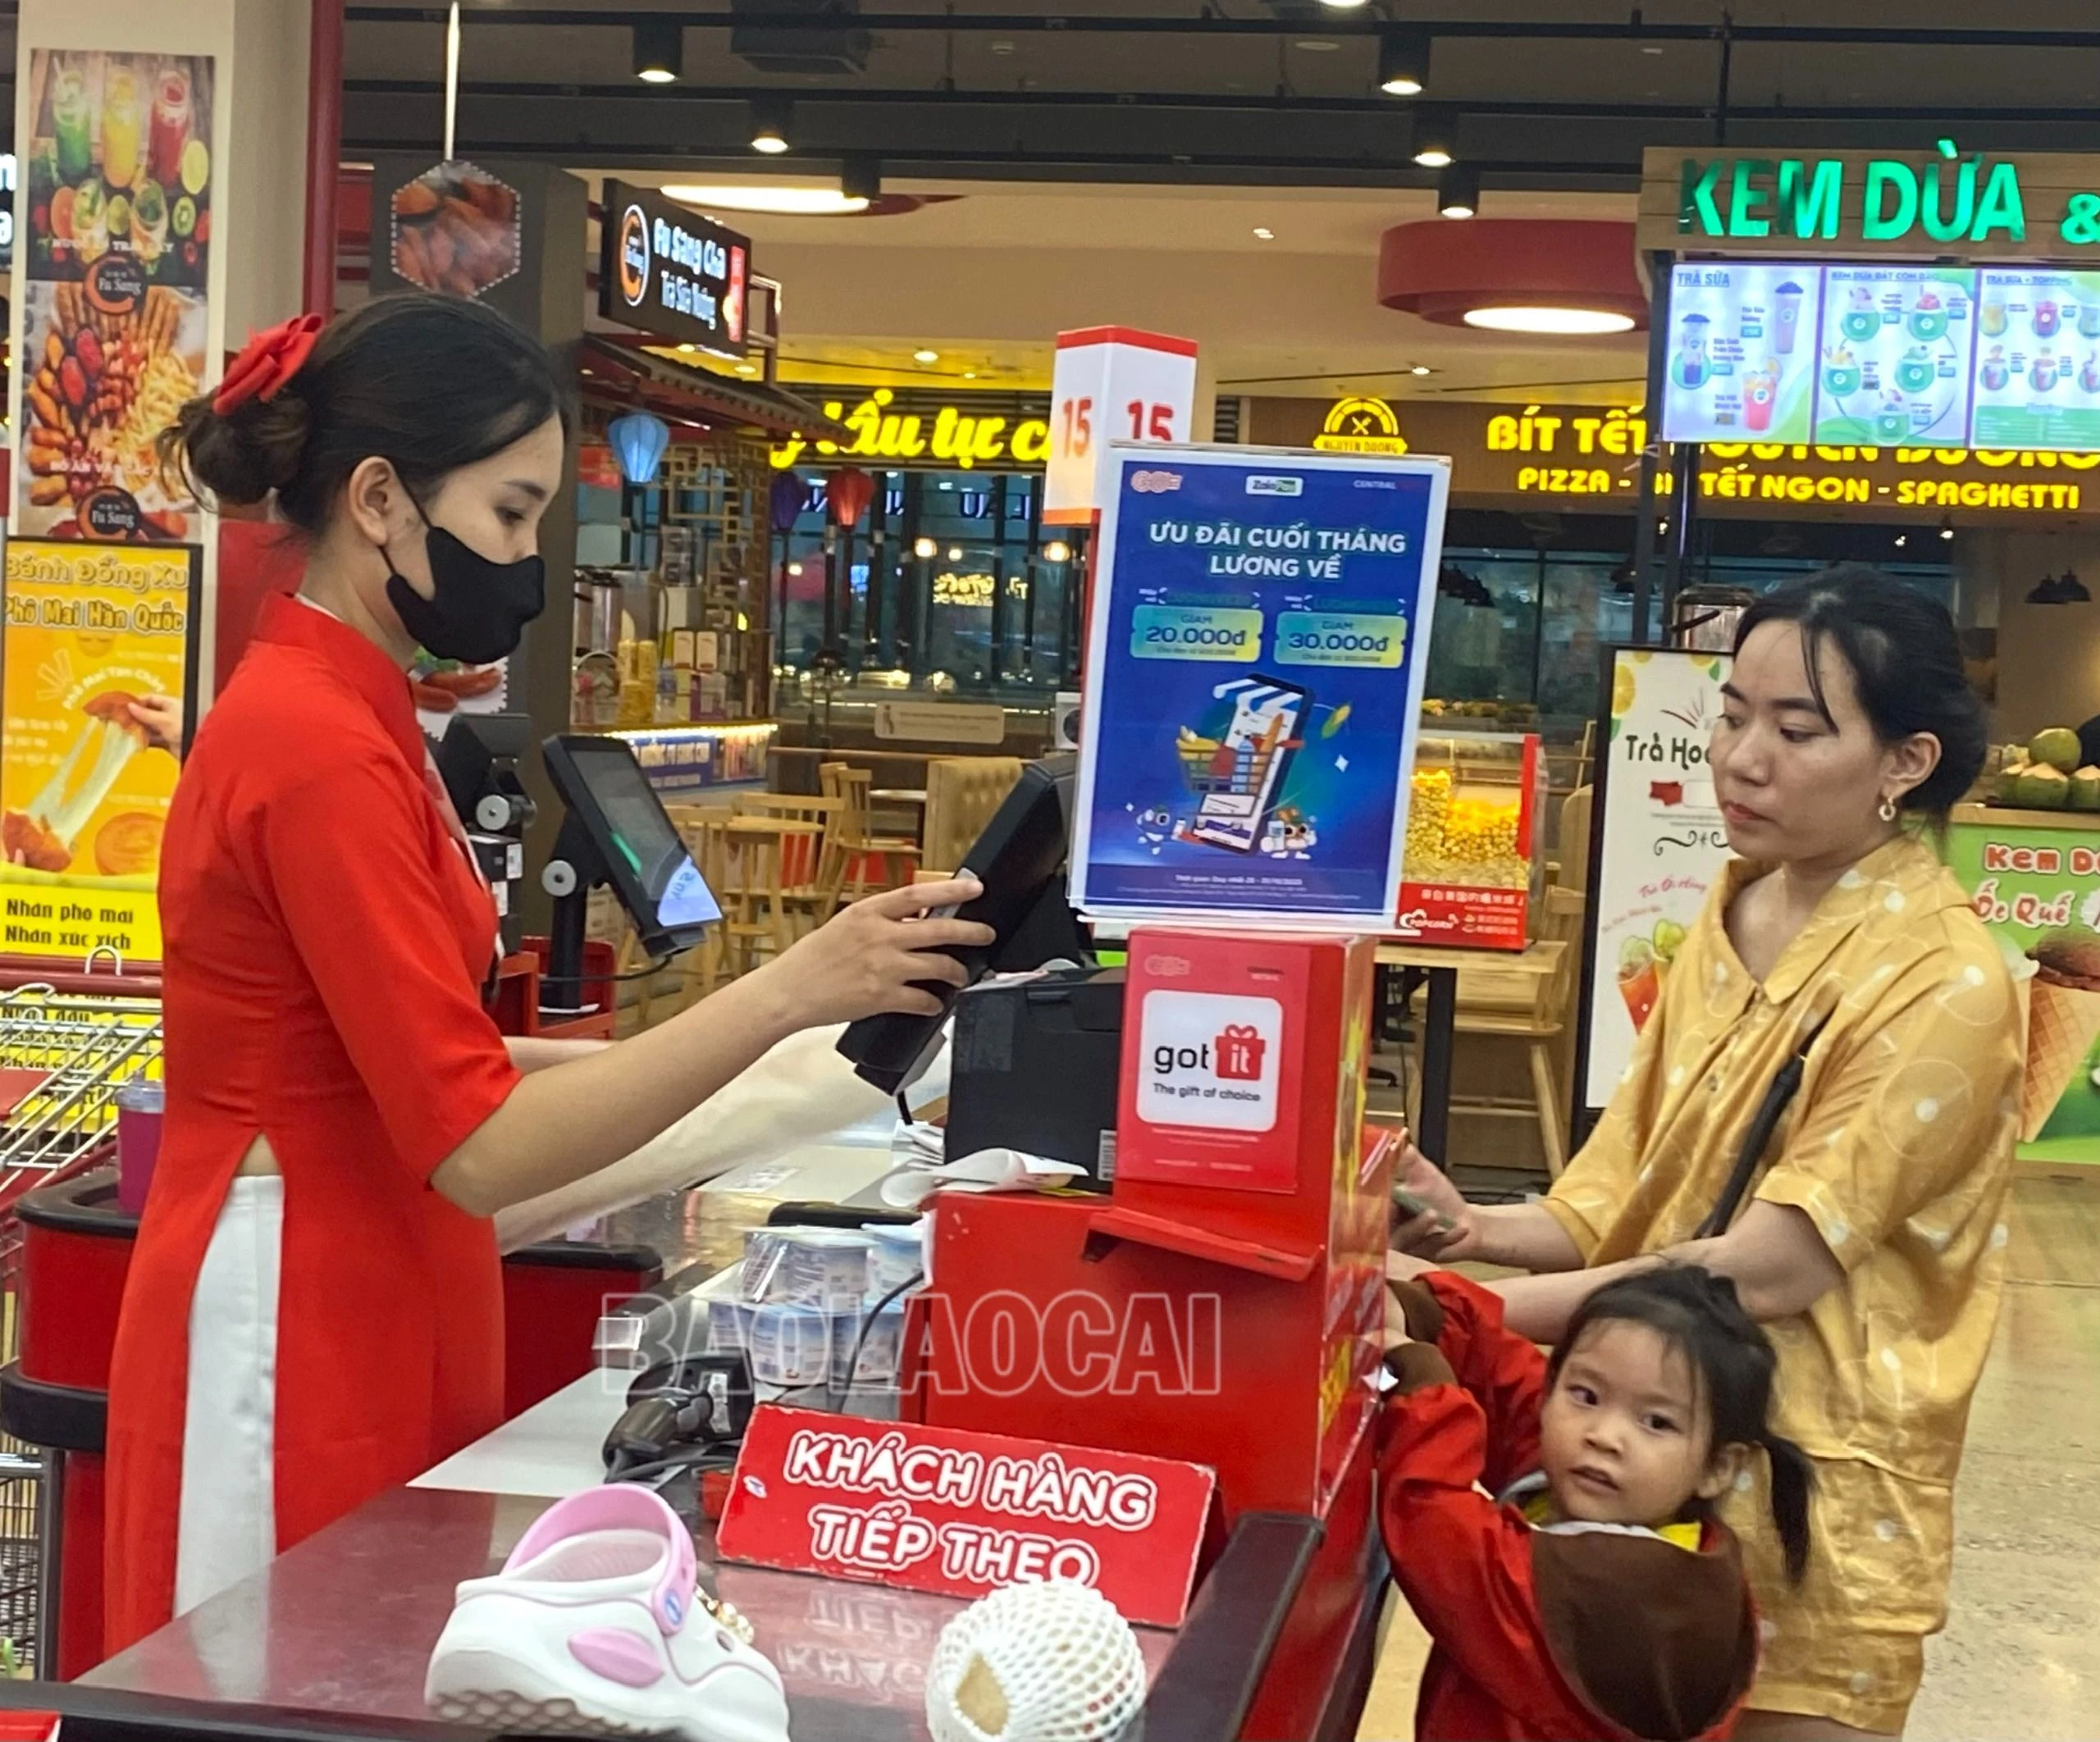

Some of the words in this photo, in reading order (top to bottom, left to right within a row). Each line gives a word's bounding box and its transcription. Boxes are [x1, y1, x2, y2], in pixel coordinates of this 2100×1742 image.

[1678, 157, 1842, 239] KEM
[1863, 138, 2025, 242] DỪA
[1063, 396, 1092, 458] 15
[1127, 399, 1174, 441] 15
[1487, 405, 1562, 453] BÍT
[1573, 404, 1646, 456] TẾT
[1518, 467, 1610, 494] PIZZA
[1699, 462, 1756, 498] TẾT
[1761, 473, 1870, 503] NGON
[1897, 481, 2081, 510] SPAGHETTI
[1150, 522, 1189, 544] ƯU
[1195, 518, 1240, 546] ĐÃI
[1247, 522, 1311, 550] CUỐI
[1317, 527, 1407, 554] THÁNG
[7, 554, 72, 585] Bánh
[1210, 554, 1299, 577] LƯƠNG
[1307, 554, 1343, 579] VỀ
[43, 597, 80, 627] Mai
[87, 599, 129, 629] Hàn
[134, 600, 185, 633] Quốc
[1146, 626, 1248, 646] 20.000đ
[1289, 632, 1389, 653] 30.000đ
[1625, 732, 1664, 762] Trà
[1984, 843, 2061, 874] Kem
[2070, 846, 2100, 876] D
[99, 908, 134, 924] mai
[2013, 891, 2075, 928] Quế
[1153, 1042, 1210, 1074] got
[1230, 1042, 1251, 1074] it
[1153, 1082, 1176, 1096] The
[1179, 1085, 1200, 1099] gift
[1203, 1086, 1217, 1098] of
[1219, 1089, 1261, 1102] choice
[783, 1430, 984, 1509] KHÁCH
[980, 1452, 1157, 1531] HÀNG
[808, 1501, 935, 1572] TIẾP
[939, 1521, 1099, 1589] THEO
